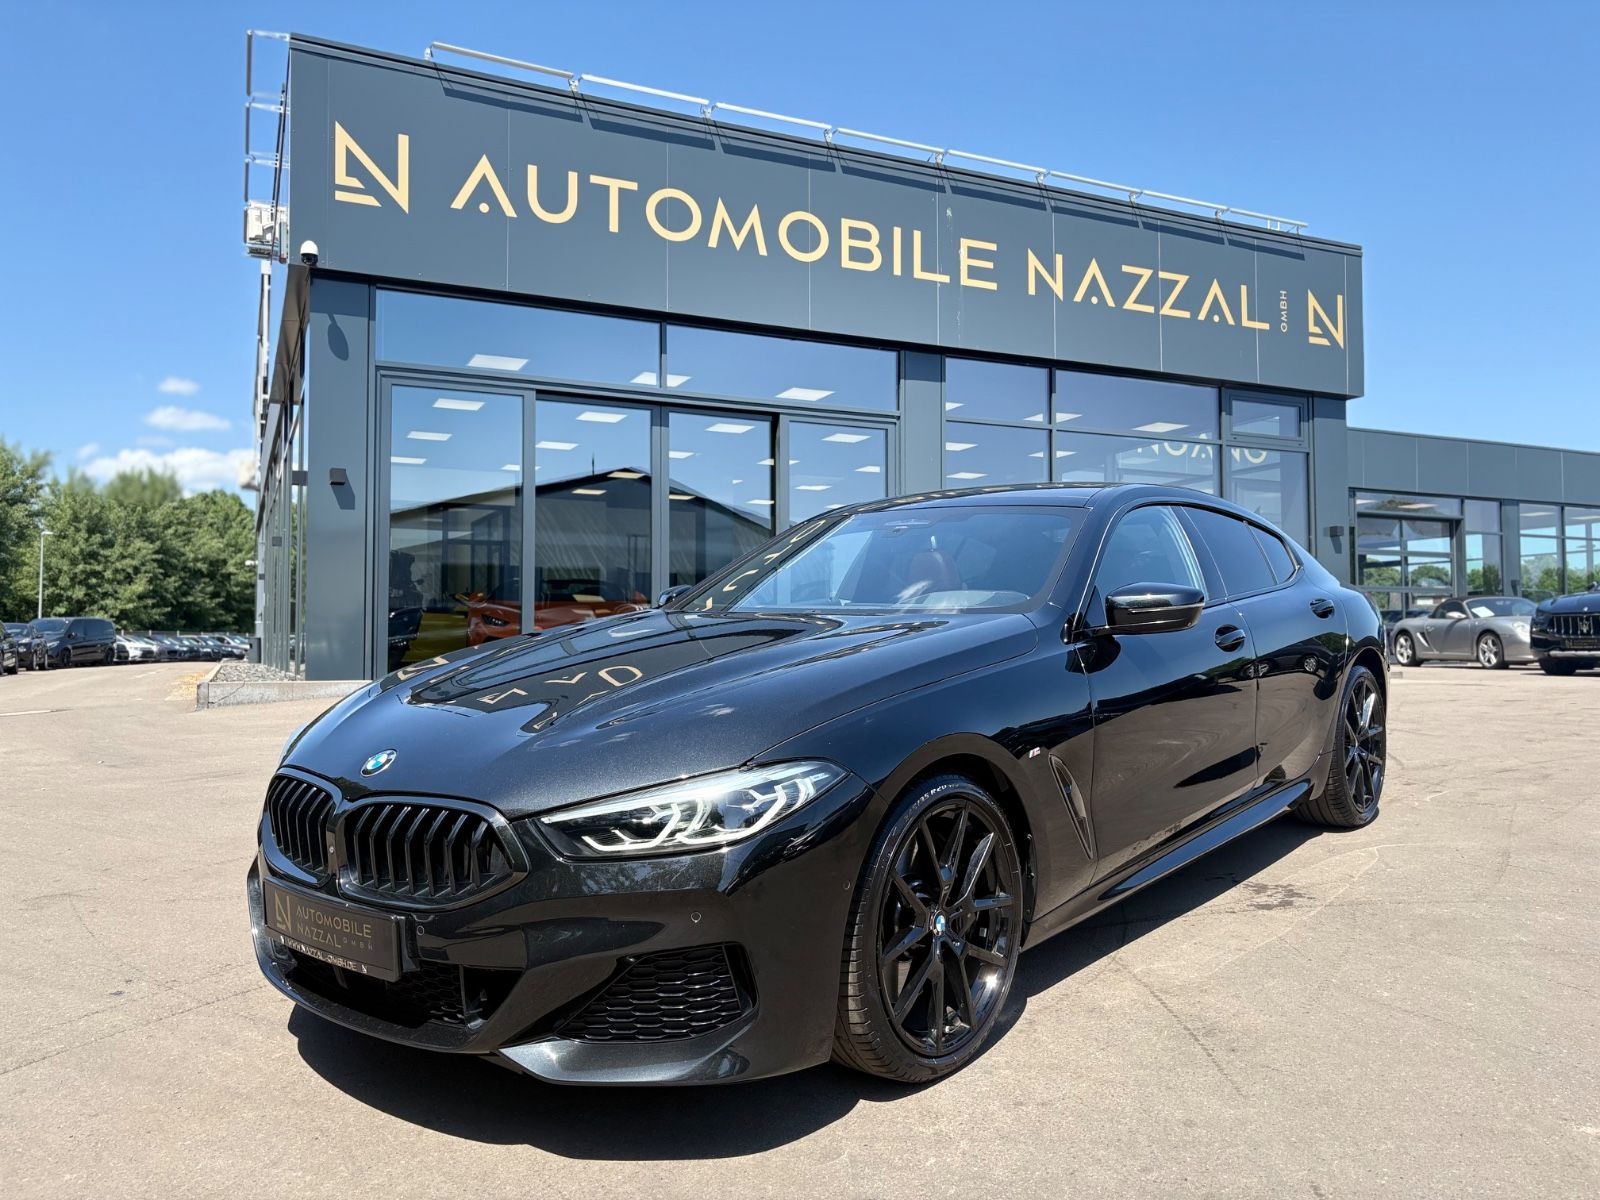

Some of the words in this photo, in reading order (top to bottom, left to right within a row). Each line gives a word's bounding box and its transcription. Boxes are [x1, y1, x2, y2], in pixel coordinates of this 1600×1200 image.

[450, 153, 998, 291] AUTOMOBILE
[1027, 247, 1270, 331] NAZZAL
[1279, 290, 1288, 333] GMBH
[296, 904, 372, 938] AUTOMOBILE
[297, 922, 342, 948] NAZZAL
